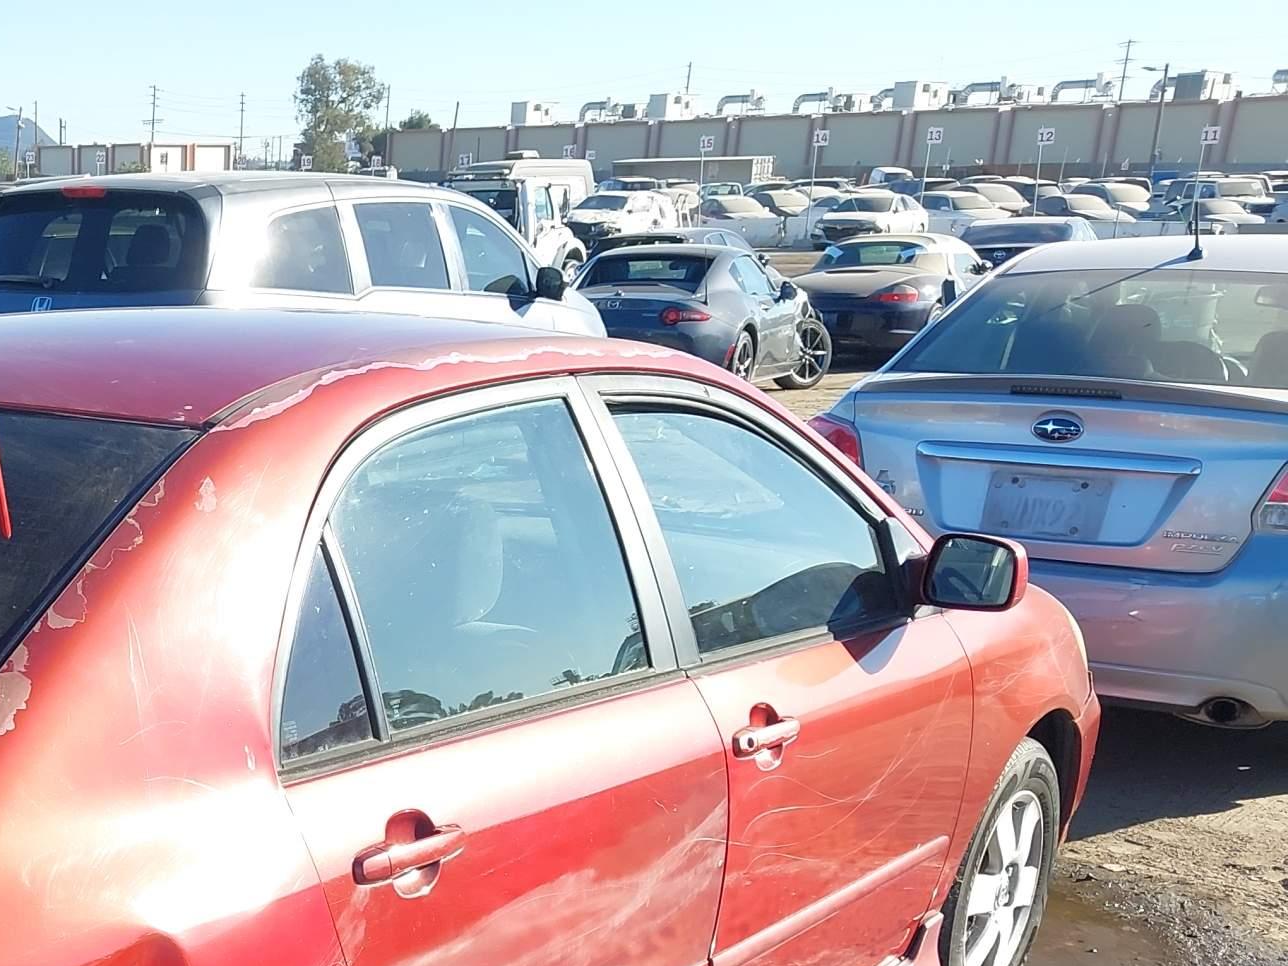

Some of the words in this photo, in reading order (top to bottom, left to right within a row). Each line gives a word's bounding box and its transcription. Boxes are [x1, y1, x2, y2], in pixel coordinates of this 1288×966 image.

[815, 133, 828, 143] 14
[927, 130, 942, 141] 13
[1039, 131, 1055, 142] 12
[1202, 130, 1218, 141] 11
[701, 138, 713, 149] 15
[1163, 530, 1241, 544] IMPRZA
